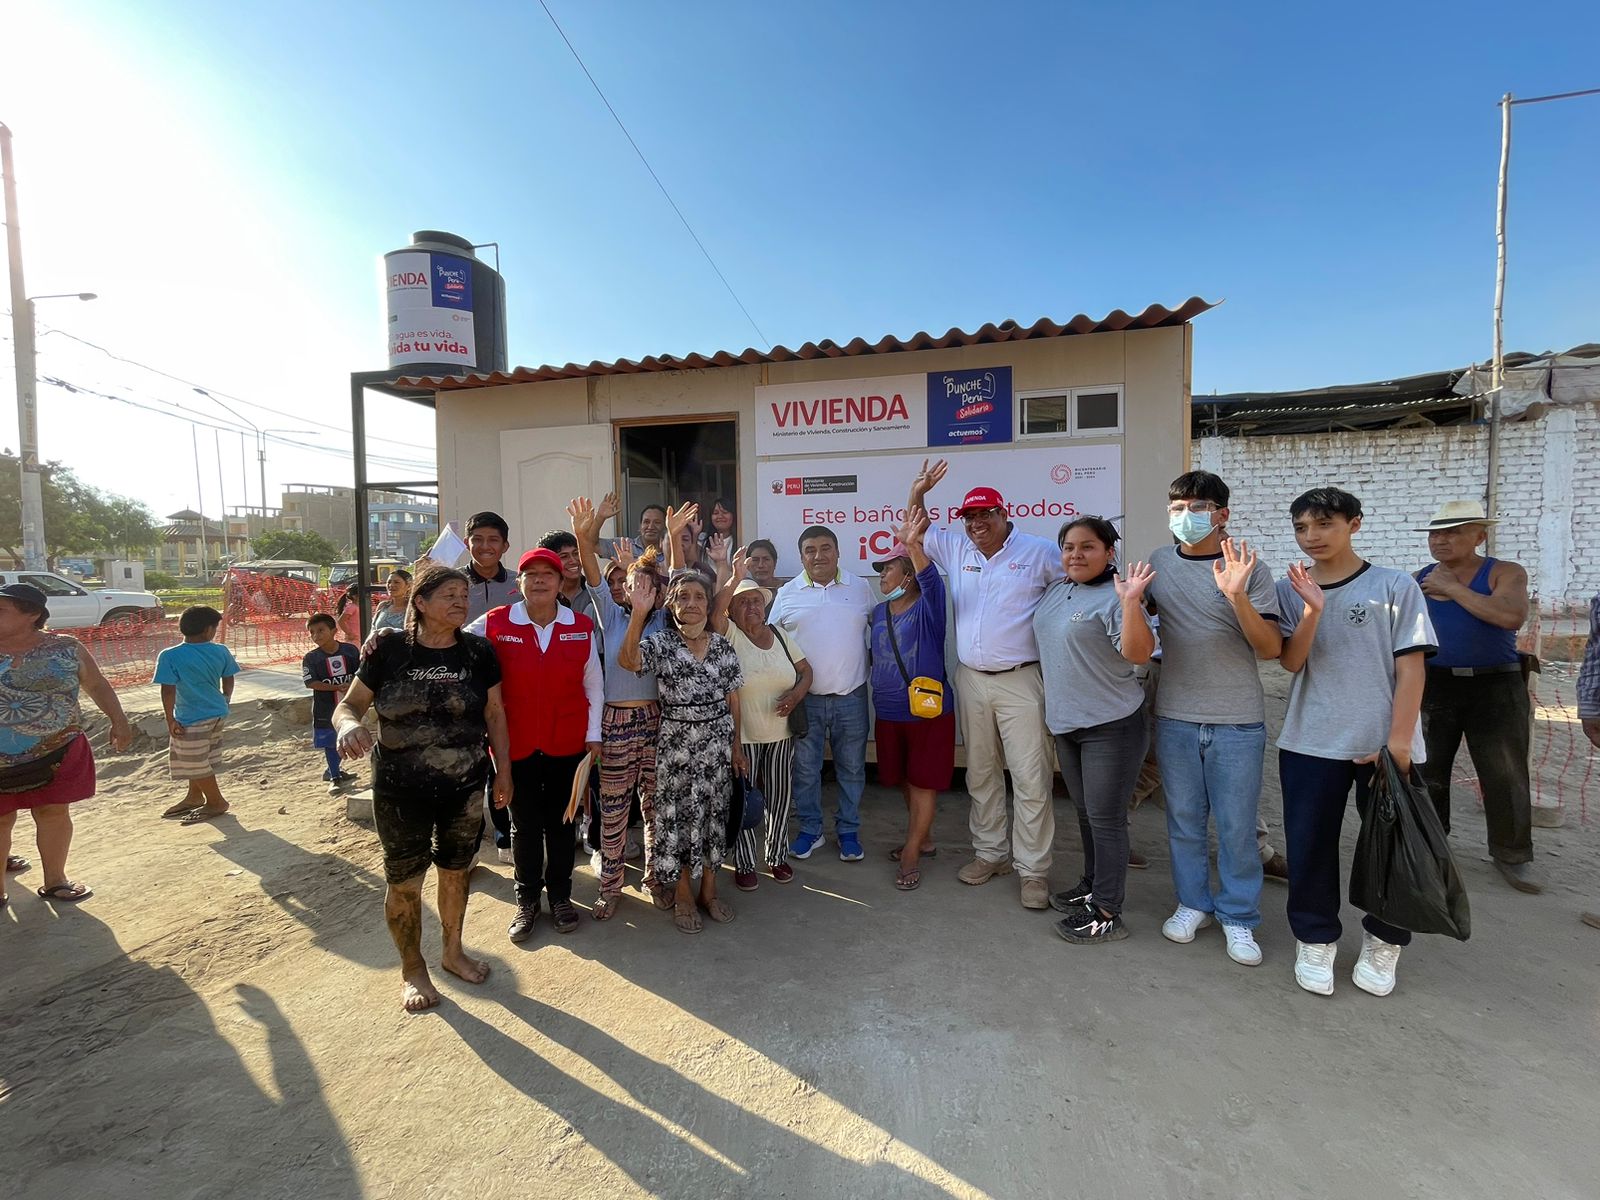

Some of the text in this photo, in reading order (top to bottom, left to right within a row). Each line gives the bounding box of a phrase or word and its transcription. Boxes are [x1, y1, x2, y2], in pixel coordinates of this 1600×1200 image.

[417, 330, 429, 338] es
[414, 341, 431, 352] tu
[434, 340, 468, 354] vida
[947, 379, 983, 398] PUNCHE
[771, 394, 909, 427] VIVIENDA
[948, 429, 983, 437] actuemos
[803, 508, 847, 525] Este
[1007, 498, 1080, 518] todos.
[407, 665, 458, 681] Welcome
